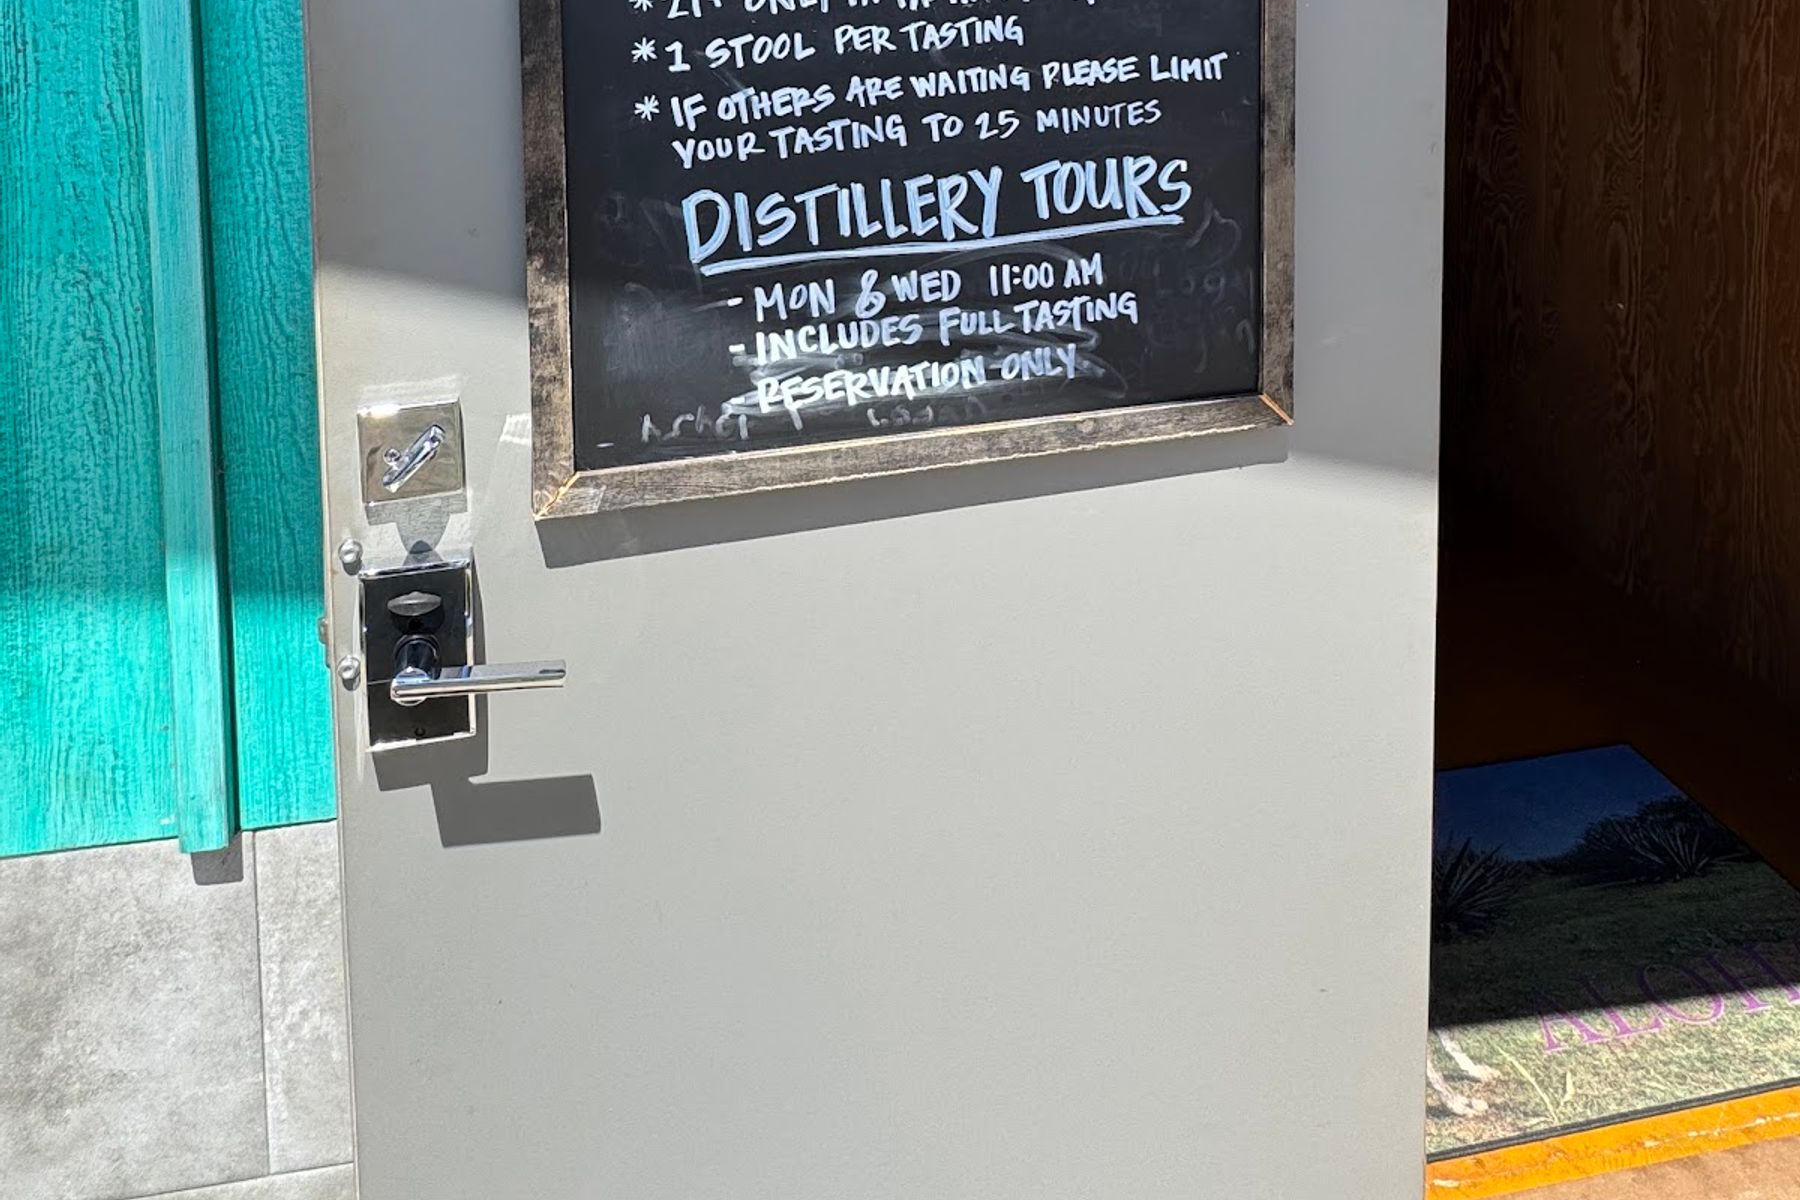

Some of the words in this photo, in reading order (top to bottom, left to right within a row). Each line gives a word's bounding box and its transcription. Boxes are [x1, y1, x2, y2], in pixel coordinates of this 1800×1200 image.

[665, 41, 690, 72] 1
[706, 33, 815, 68] STOOL
[835, 25, 896, 54] PER
[900, 16, 1023, 51] TASTING
[671, 94, 706, 131] IF
[717, 84, 836, 126] OTHERS
[846, 76, 903, 107] ARE
[910, 64, 1029, 97] WAITING
[1042, 57, 1139, 89] PLEASE
[1151, 53, 1227, 81] LIMIT
[672, 132, 765, 168] YOUR
[769, 115, 906, 158] TASTING
[922, 113, 963, 141] TO
[975, 110, 1019, 139] 25
[1037, 100, 1161, 133] MINUTES
[682, 166, 1005, 260] DISTILLERY
[1021, 155, 1192, 217] TOURS
[755, 279, 834, 322] MON
[892, 271, 960, 302] WED
[991, 263, 1053, 296] 11:00
[1064, 253, 1102, 287] AM
[755, 311, 923, 366] INCLUDES
[940, 307, 1015, 345] FULL
[1014, 292, 1137, 333] TASTING
[757, 358, 985, 414] RESERVATION
[1000, 343, 1077, 382] ONLY
[1530, 940, 1800, 1051] ALOH
